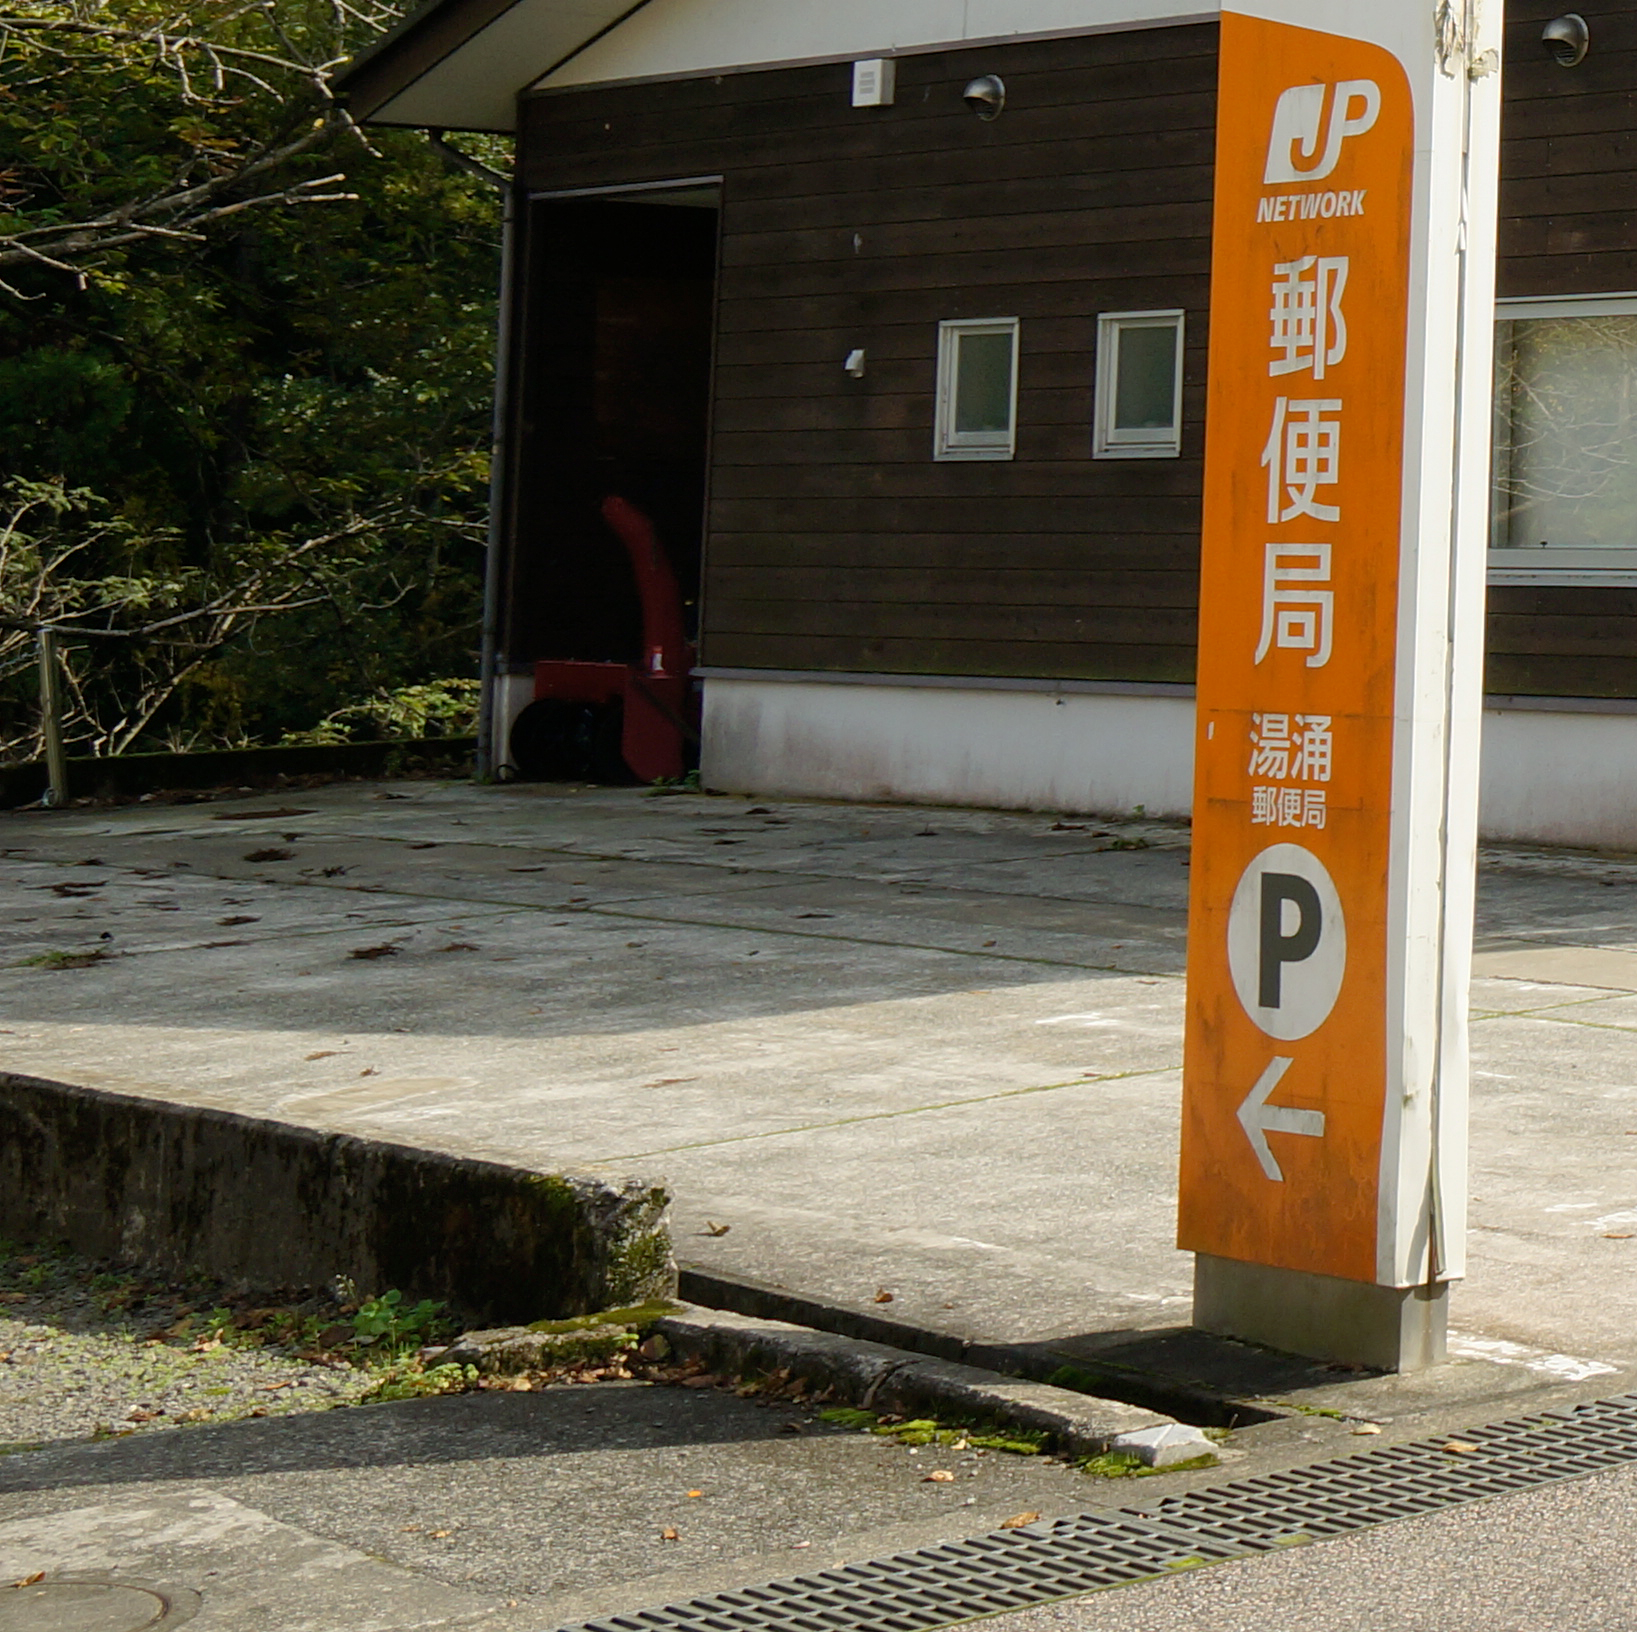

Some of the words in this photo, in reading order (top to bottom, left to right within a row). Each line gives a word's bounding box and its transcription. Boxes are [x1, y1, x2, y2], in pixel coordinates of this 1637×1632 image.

[1263, 79, 1381, 184] JP
[1257, 190, 1367, 224] NETWORK
[1254, 254, 1349, 669] 郵便局
[1248, 713, 1332, 782] 湯涌
[1251, 785, 1328, 831] 郵便局
[1258, 871, 1322, 1010] P
